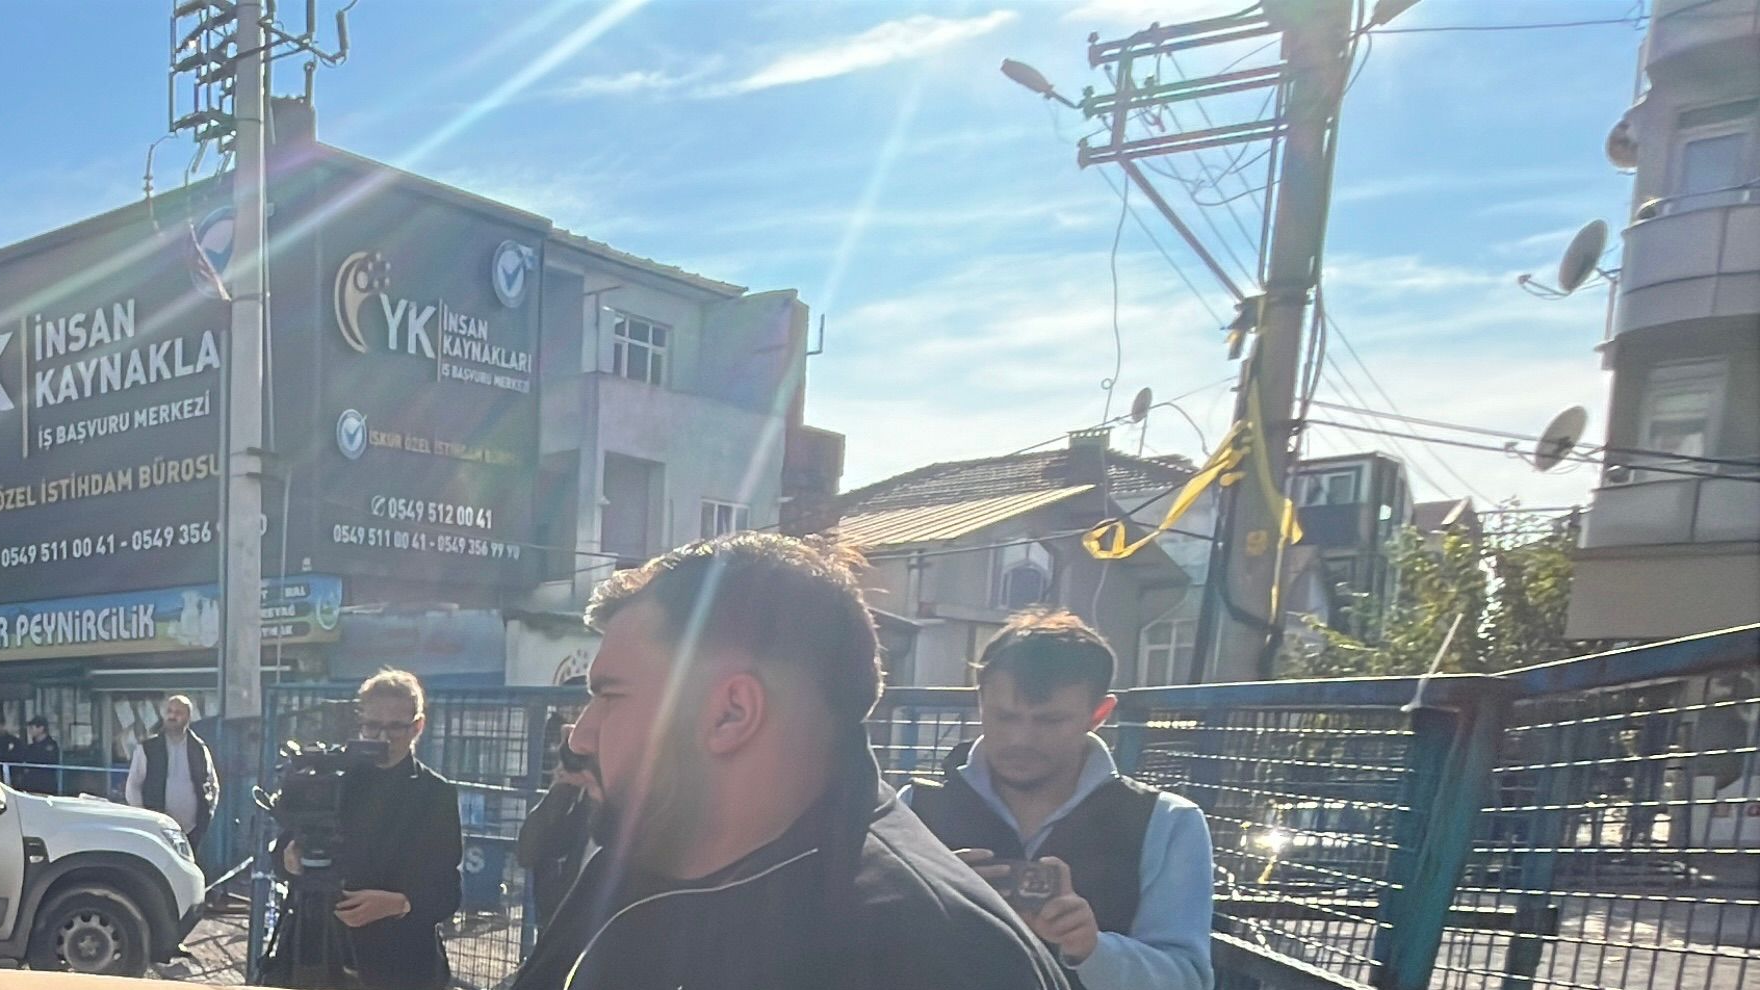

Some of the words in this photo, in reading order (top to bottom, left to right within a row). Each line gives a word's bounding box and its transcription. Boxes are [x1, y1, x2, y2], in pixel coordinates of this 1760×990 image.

[35, 299, 135, 361] İNSAN
[380, 293, 438, 359] YK
[36, 330, 221, 408] KAYNAKLA
[443, 334, 532, 374] KAYNAKLARI
[38, 426, 53, 450] İŞ
[56, 411, 130, 445] BAŞVURU
[134, 390, 210, 430] MERKEZİ
[41, 472, 132, 504] İSTİHDAM
[388, 497, 424, 522] 0549
[428, 502, 454, 525] 512
[456, 506, 473, 528] 00
[476, 508, 492, 529] 41
[2, 544, 37, 568] 0549
[41, 539, 68, 563] 511
[73, 537, 91, 559] 00
[96, 534, 115, 555] 41
[132, 525, 174, 551] 0549
[179, 520, 212, 545] 356
[333, 524, 365, 545] 0549
[368, 527, 390, 547] 511
[394, 531, 409, 550] 00
[412, 532, 426, 551] 41
[437, 535, 465, 554] 0549
[468, 538, 488, 557] 356
